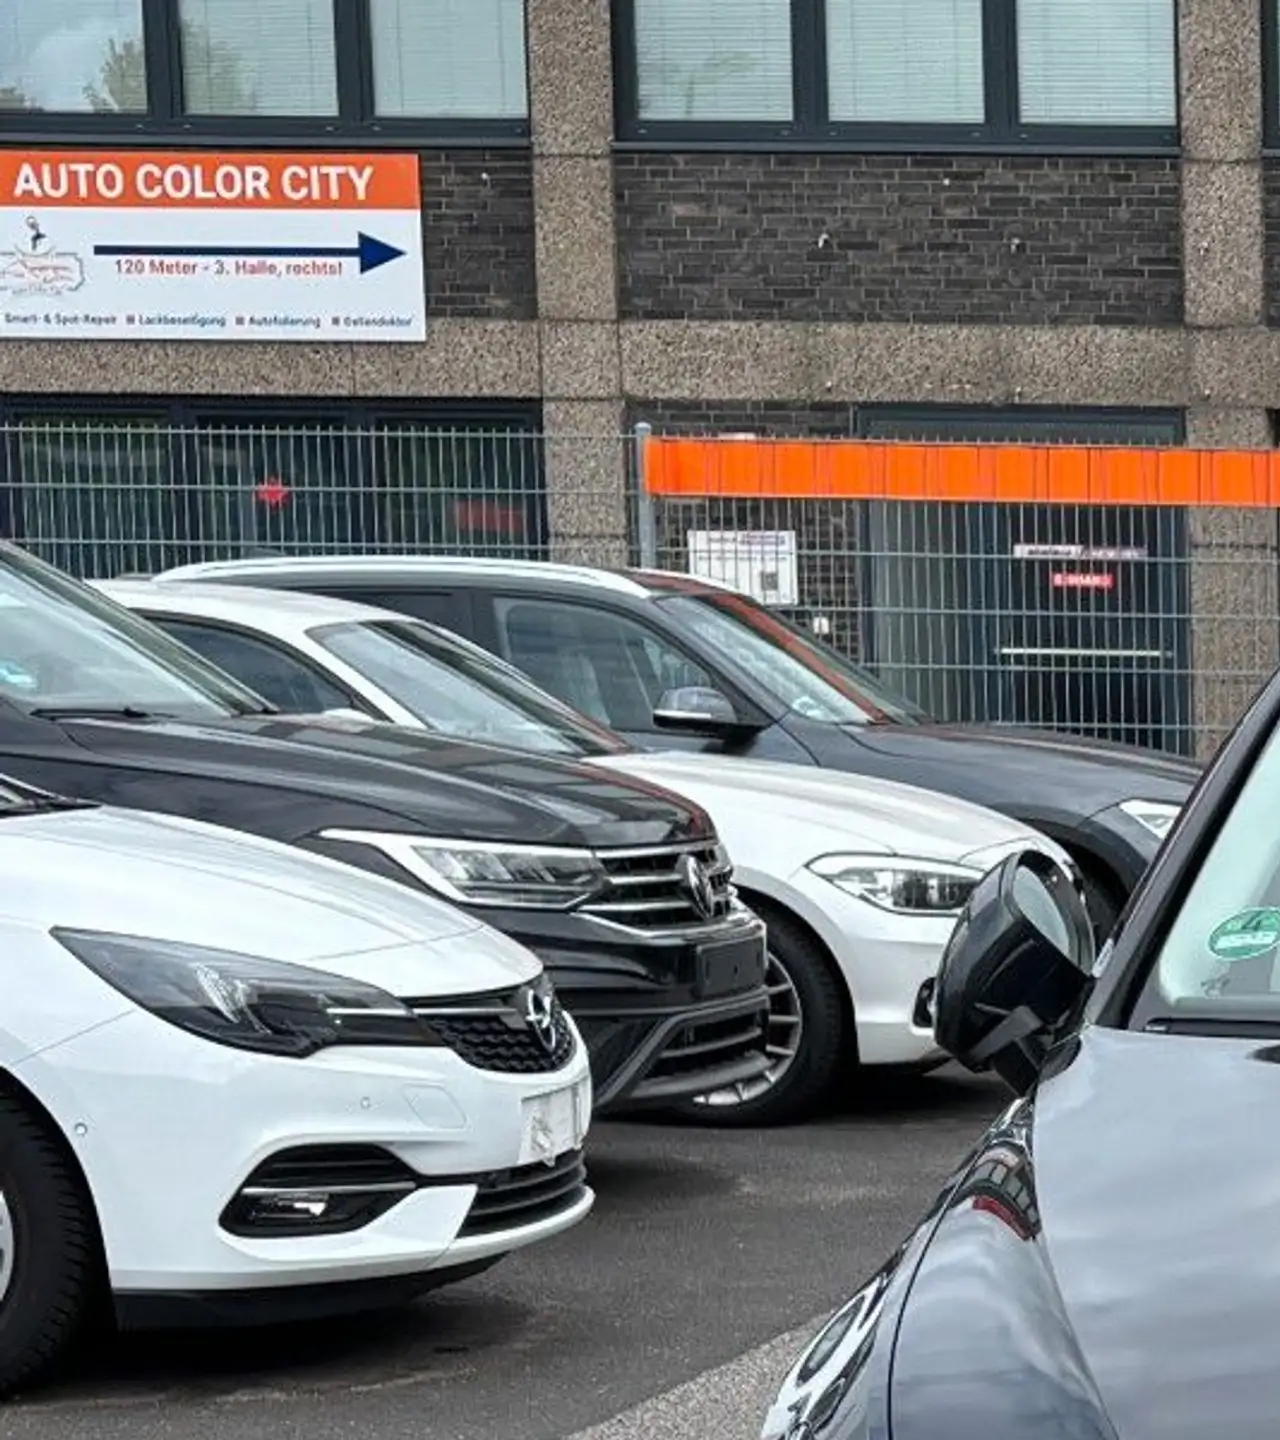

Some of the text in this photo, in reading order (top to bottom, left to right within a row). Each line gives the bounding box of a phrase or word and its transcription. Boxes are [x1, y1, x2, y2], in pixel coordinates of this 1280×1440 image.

[13, 161, 374, 200] AUTO COLOR CITY
[115, 258, 145, 274] 120
[149, 259, 198, 275] Meter
[214, 259, 229, 275] 3.
[235, 259, 282, 278] Halle,
[286, 260, 342, 277] rechts!
